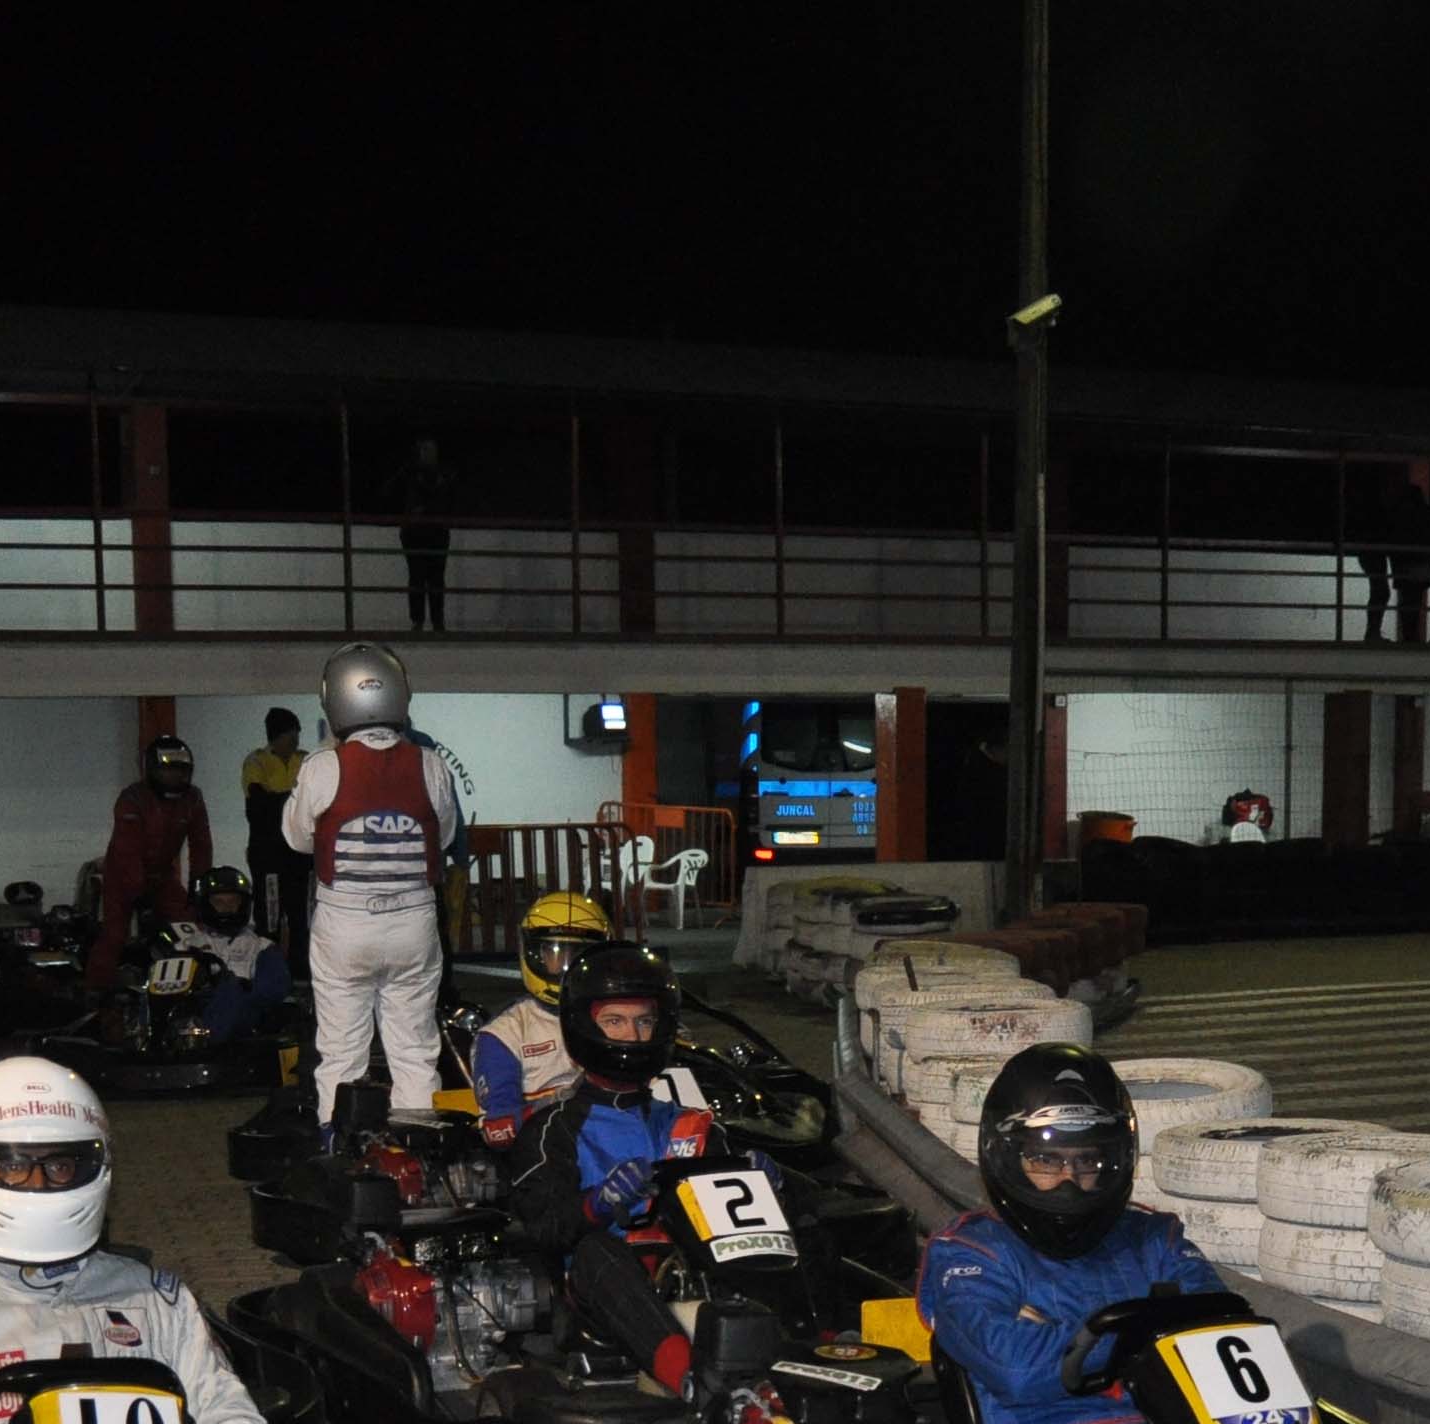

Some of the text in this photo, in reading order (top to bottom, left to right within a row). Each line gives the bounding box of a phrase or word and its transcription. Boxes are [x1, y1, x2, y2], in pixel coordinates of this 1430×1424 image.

[433, 740, 476, 797] RTING
[365, 815, 415, 834] SAP
[775, 804, 816, 817] JUNCAL
[159, 960, 185, 981] 11
[713, 1178, 767, 1228] 2
[1216, 1336, 1271, 1404] 6
